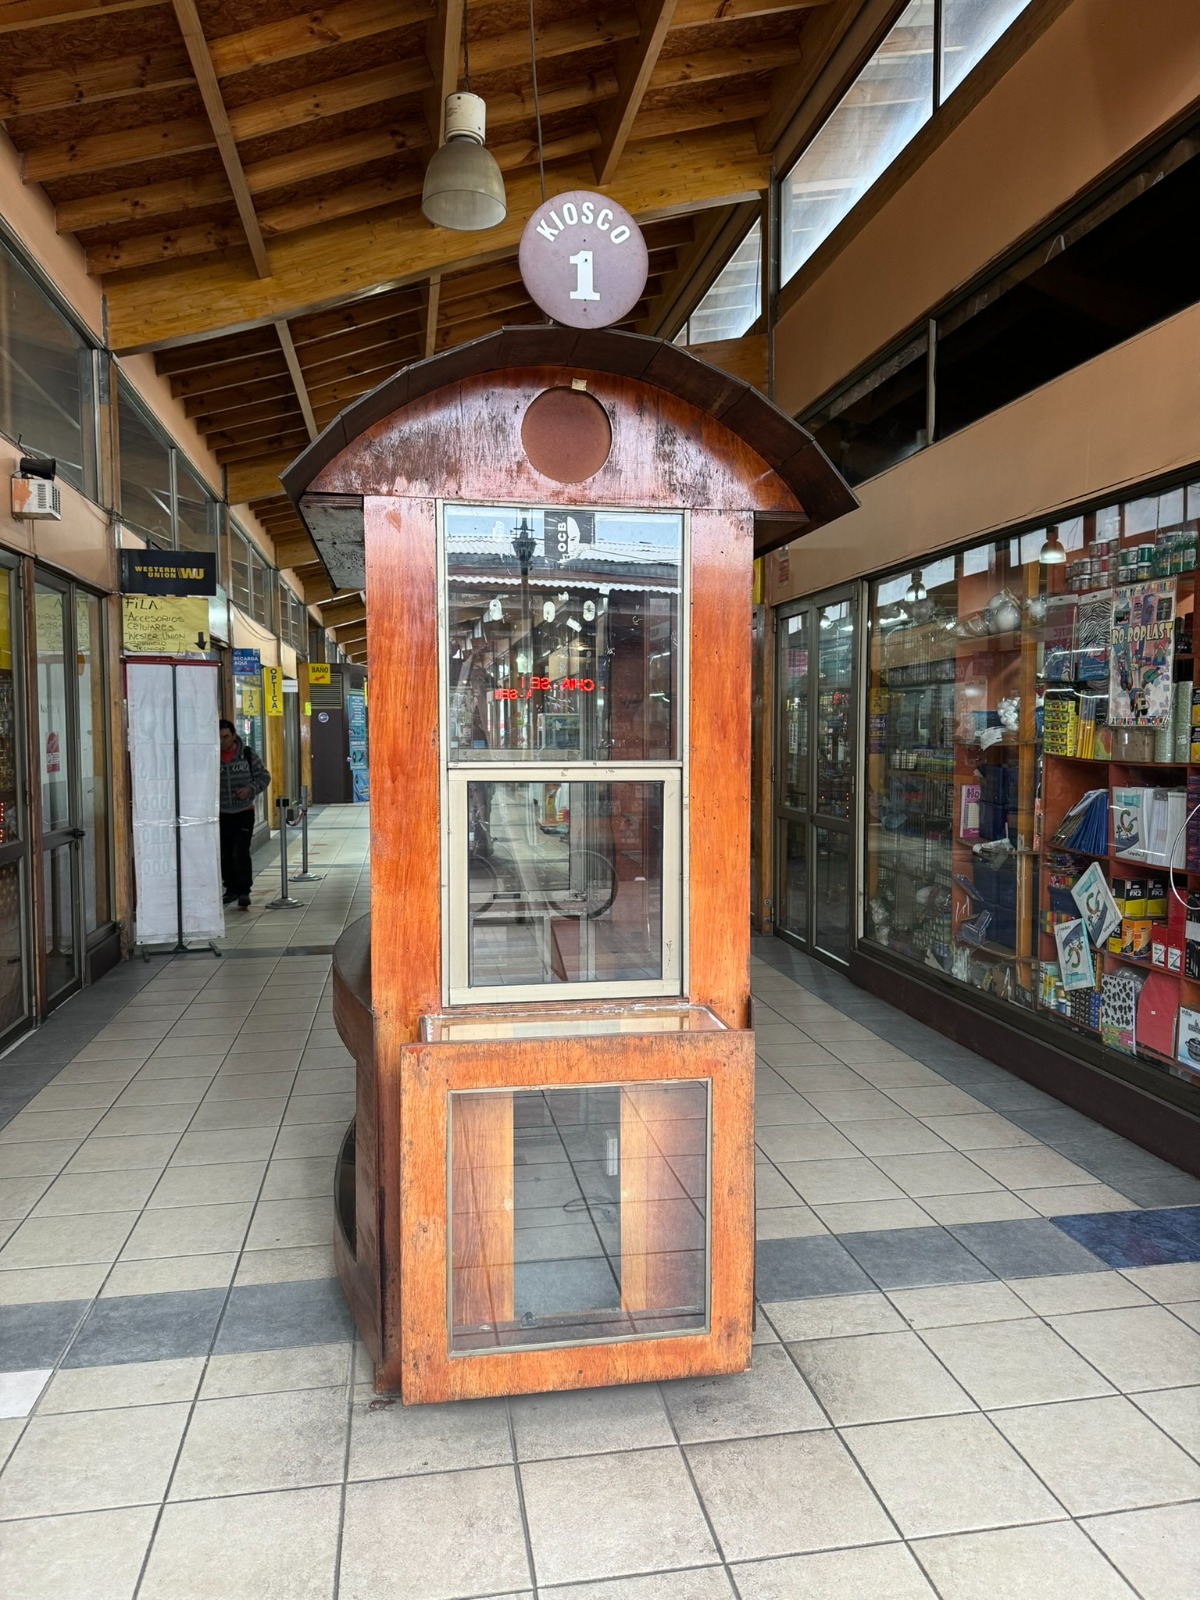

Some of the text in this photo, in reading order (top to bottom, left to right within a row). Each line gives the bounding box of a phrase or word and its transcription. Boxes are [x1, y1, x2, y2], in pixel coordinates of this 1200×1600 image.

[535, 201, 630, 245] KIOSCO
[569, 250, 600, 301] 1
[557, 521, 567, 552] OCB
[134, 565, 177, 573] WESTERN
[177, 567, 205, 579] WU
[1111, 620, 1174, 645] RO-ROPLAST
[311, 665, 329, 673] BAÑO
